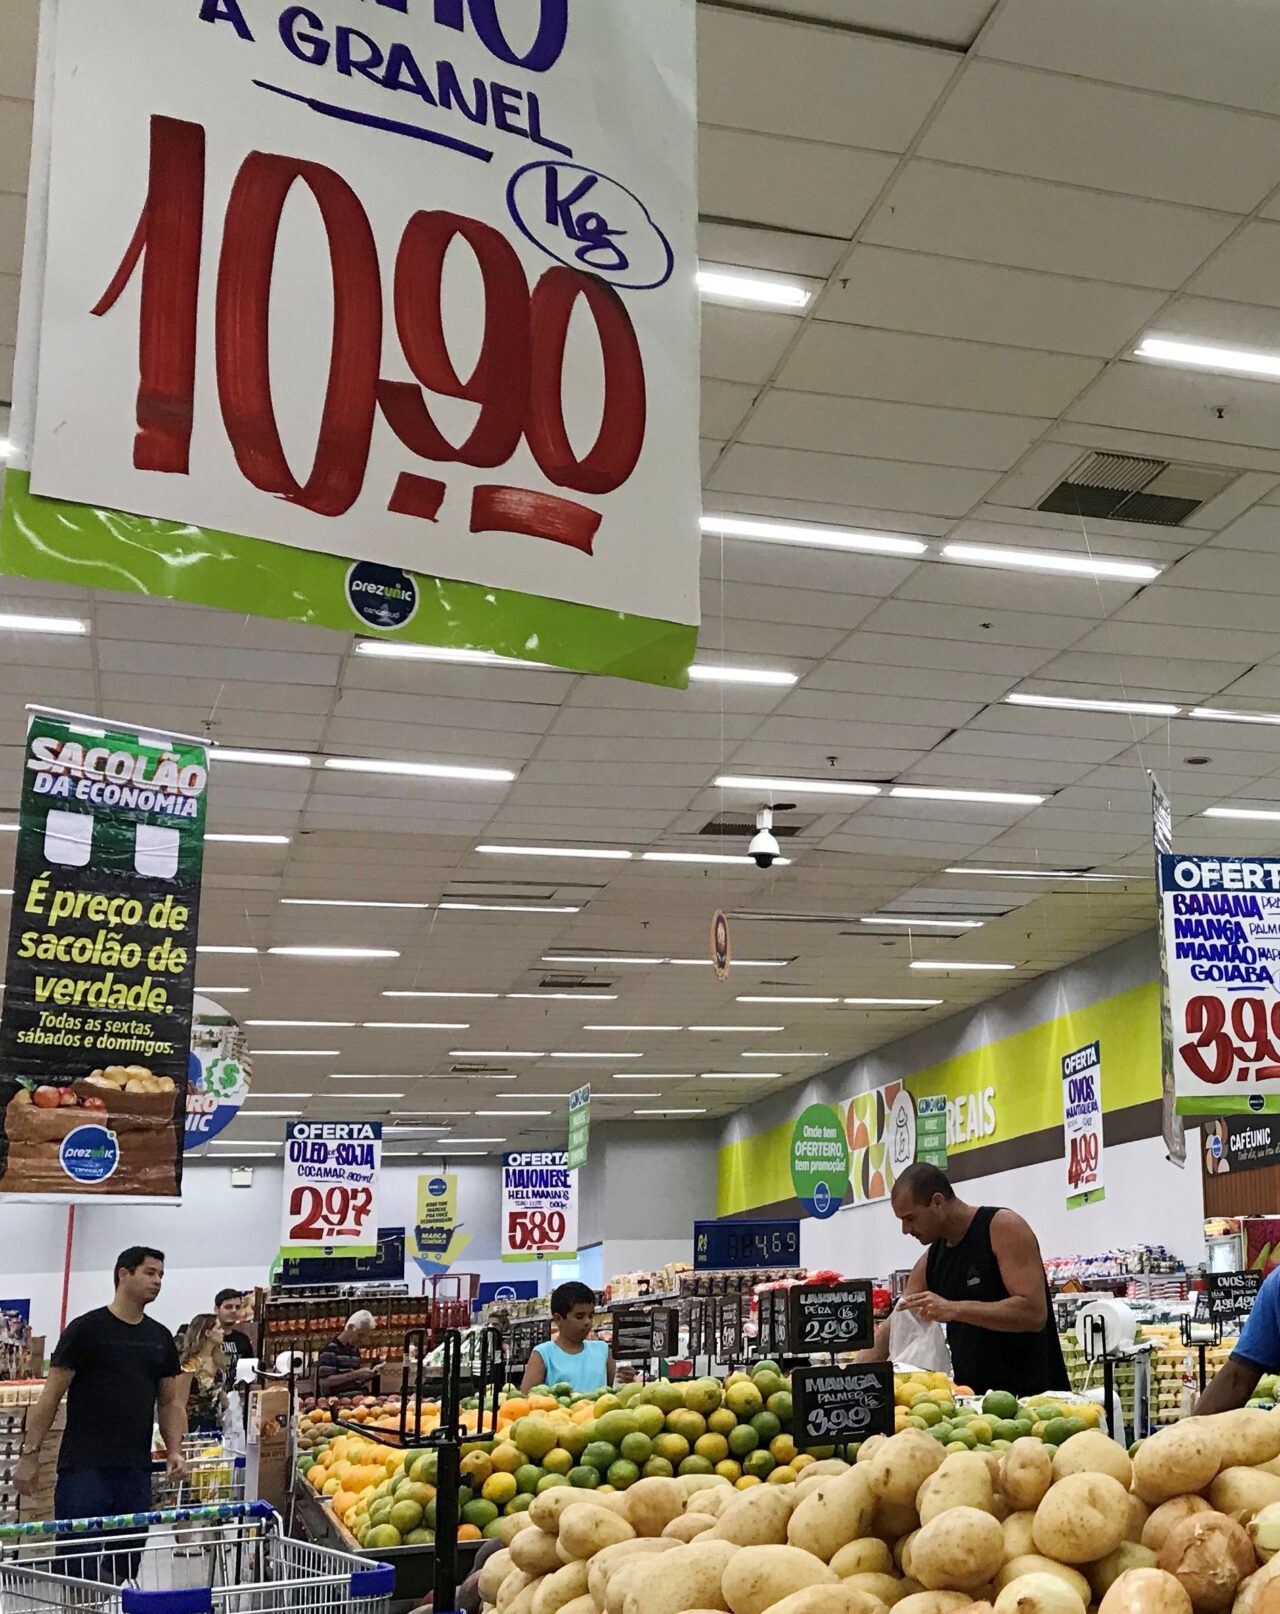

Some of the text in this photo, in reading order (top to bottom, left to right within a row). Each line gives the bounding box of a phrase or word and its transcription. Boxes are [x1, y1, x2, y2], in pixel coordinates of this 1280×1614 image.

[198, 0, 256, 43] A
[278, 5, 573, 158] GRANEL
[27, 737, 207, 797] SACOLÃO
[33, 772, 198, 818] DA ECONOMIA
[24, 871, 188, 931] É preço de
[1173, 893, 1264, 921] BANANA
[1174, 918, 1249, 945] MANGA
[17, 929, 187, 973] sacolão de
[1190, 964, 1275, 985] GOIABA
[34, 972, 174, 1014] verdade.
[38, 1011, 155, 1037] Todas as sextas,
[16, 1028, 174, 1057] sábados e domingos.
[1065, 1047, 1097, 1074] OFERTA
[1069, 1075, 1095, 1104] OVOS
[293, 1124, 374, 1139] OFERTA
[804, 1125, 837, 1138] Onde tem
[1230, 1127, 1271, 1151] CAFÉUNIC
[336, 1142, 375, 1169] SOJA
[508, 1152, 569, 1165] OFERTA
[795, 1141, 844, 1156] OFERTEIRO,
[298, 1165, 345, 1179] COCAMAR
[795, 1160, 809, 1170] tem
[505, 1168, 571, 1189] MAIONESE
[1217, 1276, 1245, 1287] OVOS
[805, 1373, 882, 1392] MANGA
[818, 1391, 863, 1404] PALMER
